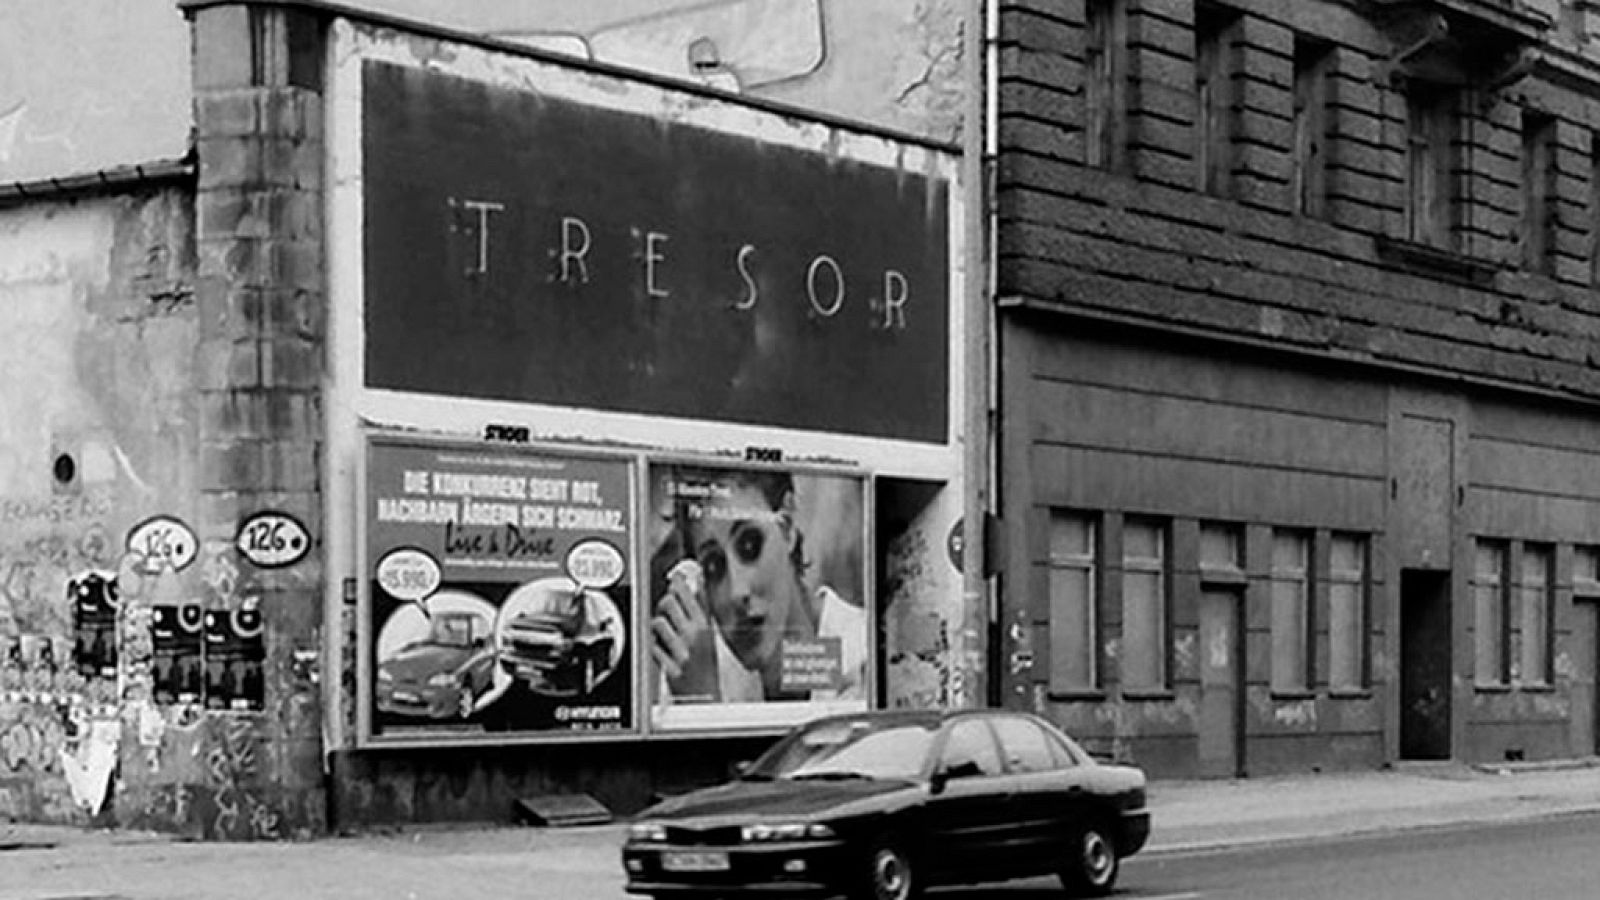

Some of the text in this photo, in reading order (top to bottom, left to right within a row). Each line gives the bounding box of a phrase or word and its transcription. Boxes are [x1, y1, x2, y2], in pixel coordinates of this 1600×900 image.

[464, 199, 909, 328] TRESOR
[405, 471, 429, 493] DIE
[249, 521, 286, 550] 126
